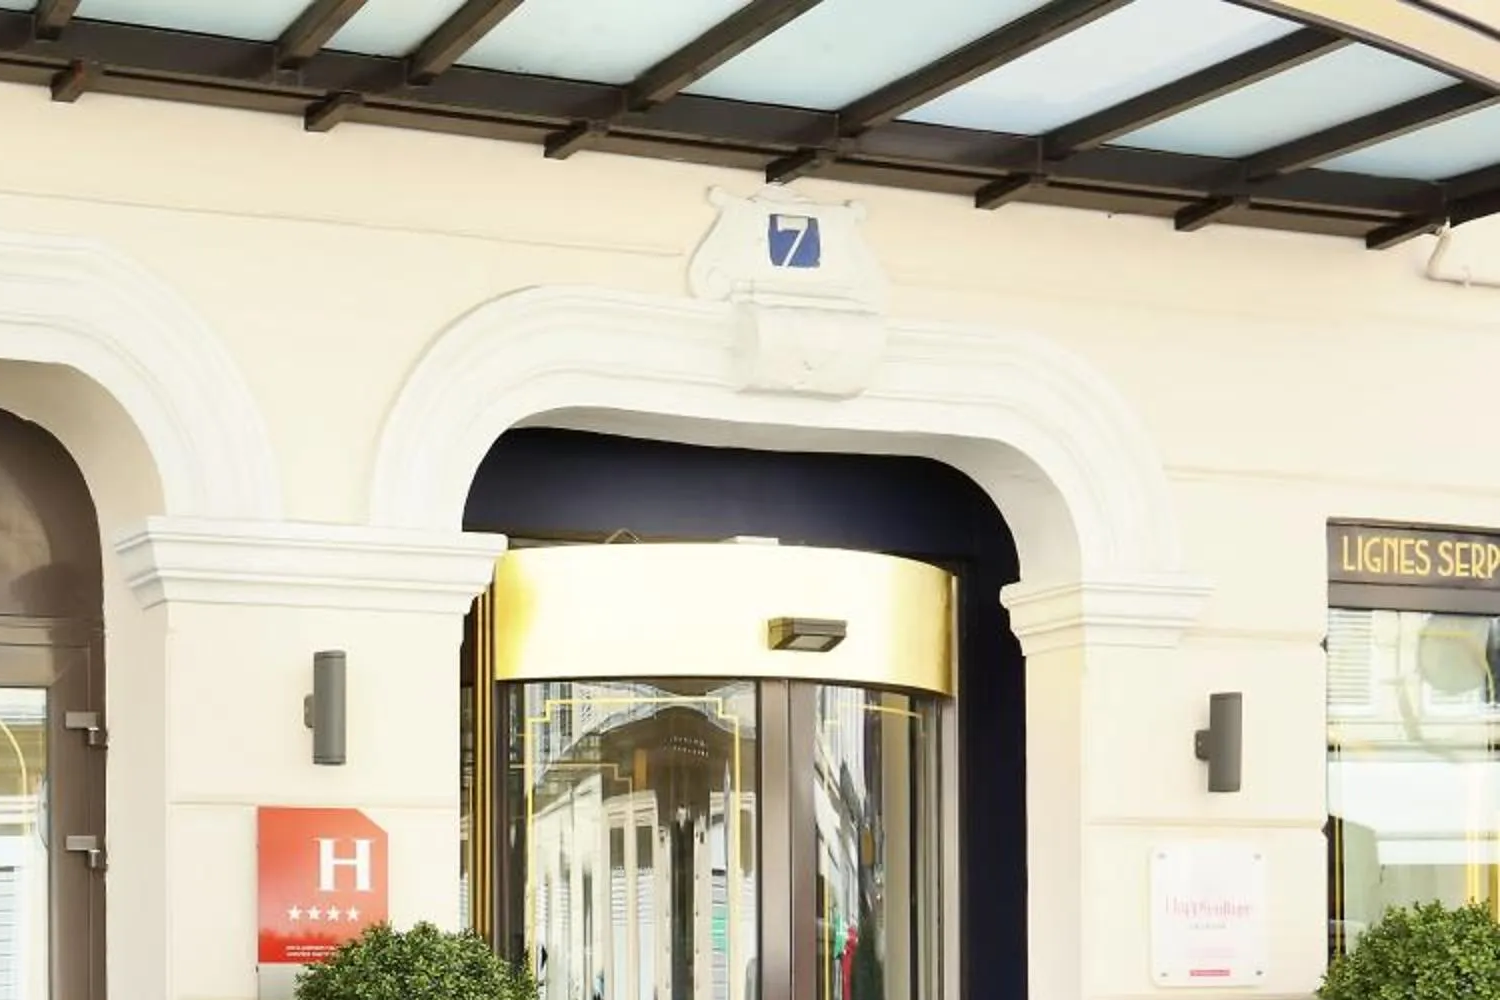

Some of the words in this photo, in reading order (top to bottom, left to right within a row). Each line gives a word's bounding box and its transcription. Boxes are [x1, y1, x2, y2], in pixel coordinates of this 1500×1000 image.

[777, 216, 809, 267] 7
[1342, 535, 1431, 576] LIGNES
[1437, 541, 1500, 579] SERP
[318, 838, 372, 892] H
